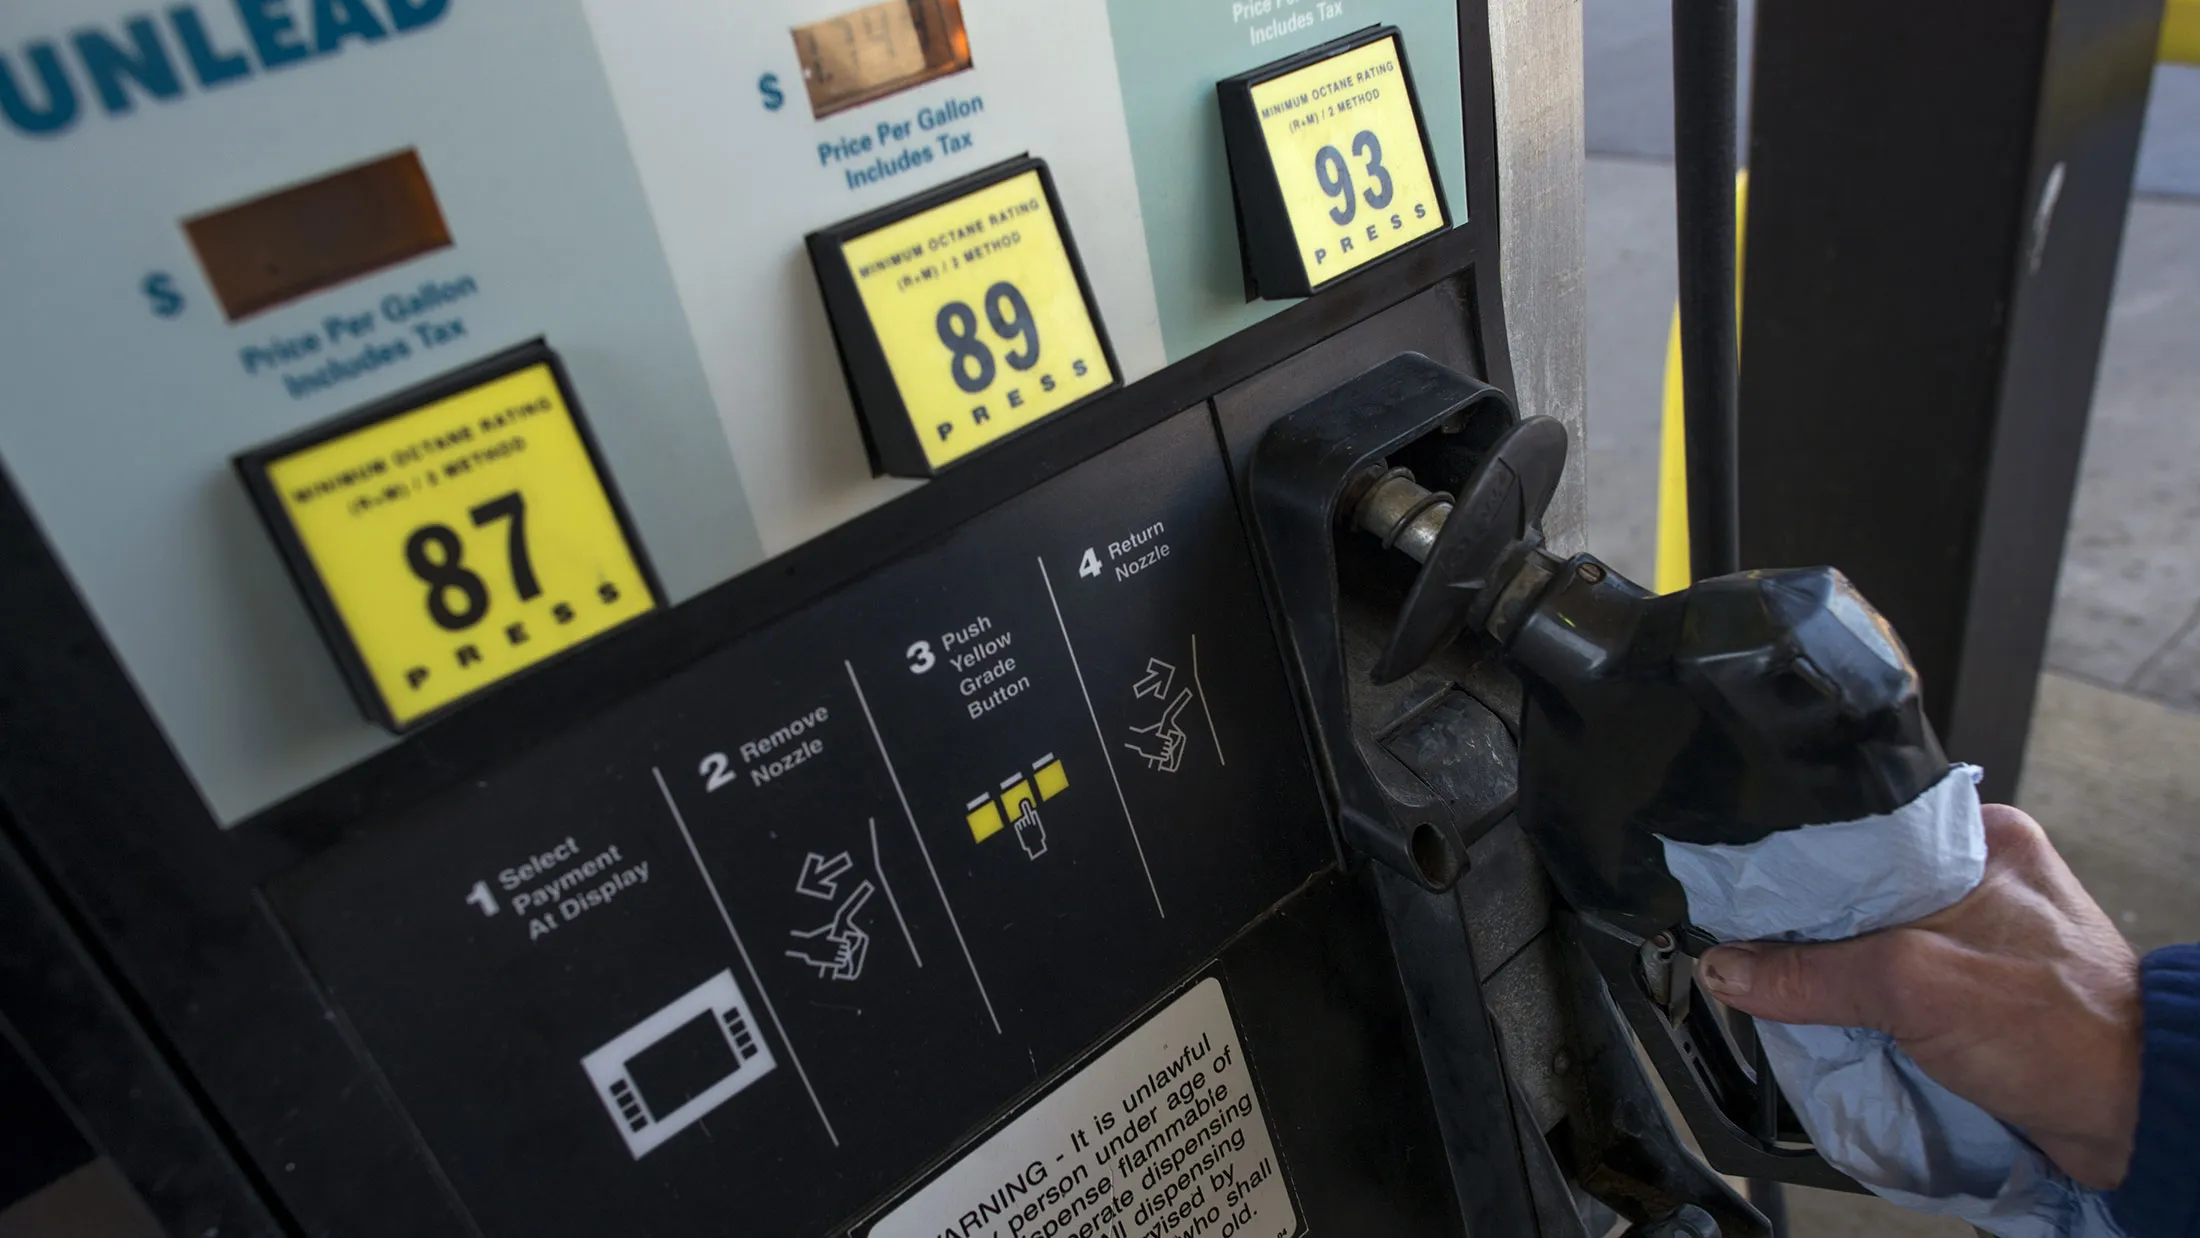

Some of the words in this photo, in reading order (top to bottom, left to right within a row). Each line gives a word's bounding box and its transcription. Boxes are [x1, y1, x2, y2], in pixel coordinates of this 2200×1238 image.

[1232, 0, 1273, 23] Price
[1250, 12, 1315, 46] Includes
[1317, 1, 1344, 22] Tax
[757, 72, 785, 112] $
[1261, 92, 1309, 120] MINIMUM
[1312, 77, 1354, 101] OCTANE
[1356, 61, 1395, 83] RATING
[1289, 113, 1320, 134] (R+M)
[1328, 105, 1336, 118] 2
[1337, 88, 1381, 113] METHOD
[817, 135, 873, 167] Price
[876, 121, 911, 147] Per
[917, 95, 984, 131] Gallon
[845, 143, 934, 190] Includes
[936, 131, 973, 155] Tax
[1315, 130, 1393, 226] 93
[859, 245, 924, 278] MINIMUM
[927, 221, 985, 252] OCTANE
[989, 198, 1040, 227] RATING
[963, 231, 1022, 263] METHOD
[1314, 203, 1426, 265] PRESS
[139, 269, 186, 321] $
[239, 332, 322, 375] Price
[322, 311, 376, 345] Per
[380, 274, 479, 323] Gallon
[936, 281, 1040, 394] 89
[282, 338, 413, 400] Includes
[412, 317, 468, 349] Tax
[478, 396, 553, 433] RATING
[936, 359, 1088, 442] PRESS
[404, 490, 544, 633] 87
[1079, 547, 1103, 579] 4
[1107, 521, 1165, 560] Return
[1115, 544, 1170, 582] Nozzle
[405, 582, 621, 692] PRESS
[906, 640, 936, 674] 3
[941, 616, 992, 652] Push
[949, 631, 1012, 673] Yellow
[960, 657, 1016, 696] Grade
[967, 676, 1030, 720] Button
[739, 707, 829, 763] Remove
[699, 752, 737, 793] 2
[750, 738, 824, 787] Nozzle
[499, 836, 580, 891] Select
[512, 844, 623, 916] Payment
[466, 880, 500, 917] 1
[529, 912, 559, 941] At
[559, 860, 649, 921] Display
[937, 1160, 1048, 1238] RNING
[1069, 1128, 1090, 1153] It
[1093, 1110, 1115, 1135] is
[1122, 1032, 1212, 1113] unlawful
[1008, 1164, 1089, 1238] person
[1095, 1106, 1158, 1166] under
[1167, 1071, 1206, 1111] age
[1213, 1044, 1232, 1073] of
[1118, 1084, 1228, 1178] flammable
[1068, 1190, 1134, 1238] erate
[1142, 1093, 1252, 1190] dispensing
[1101, 1220, 1127, 1238] ll
[1134, 1128, 1245, 1226] dispensing
[1210, 1163, 1234, 1193] by
[1227, 1158, 1272, 1207] shall
[1222, 1202, 1257, 1238] old.
